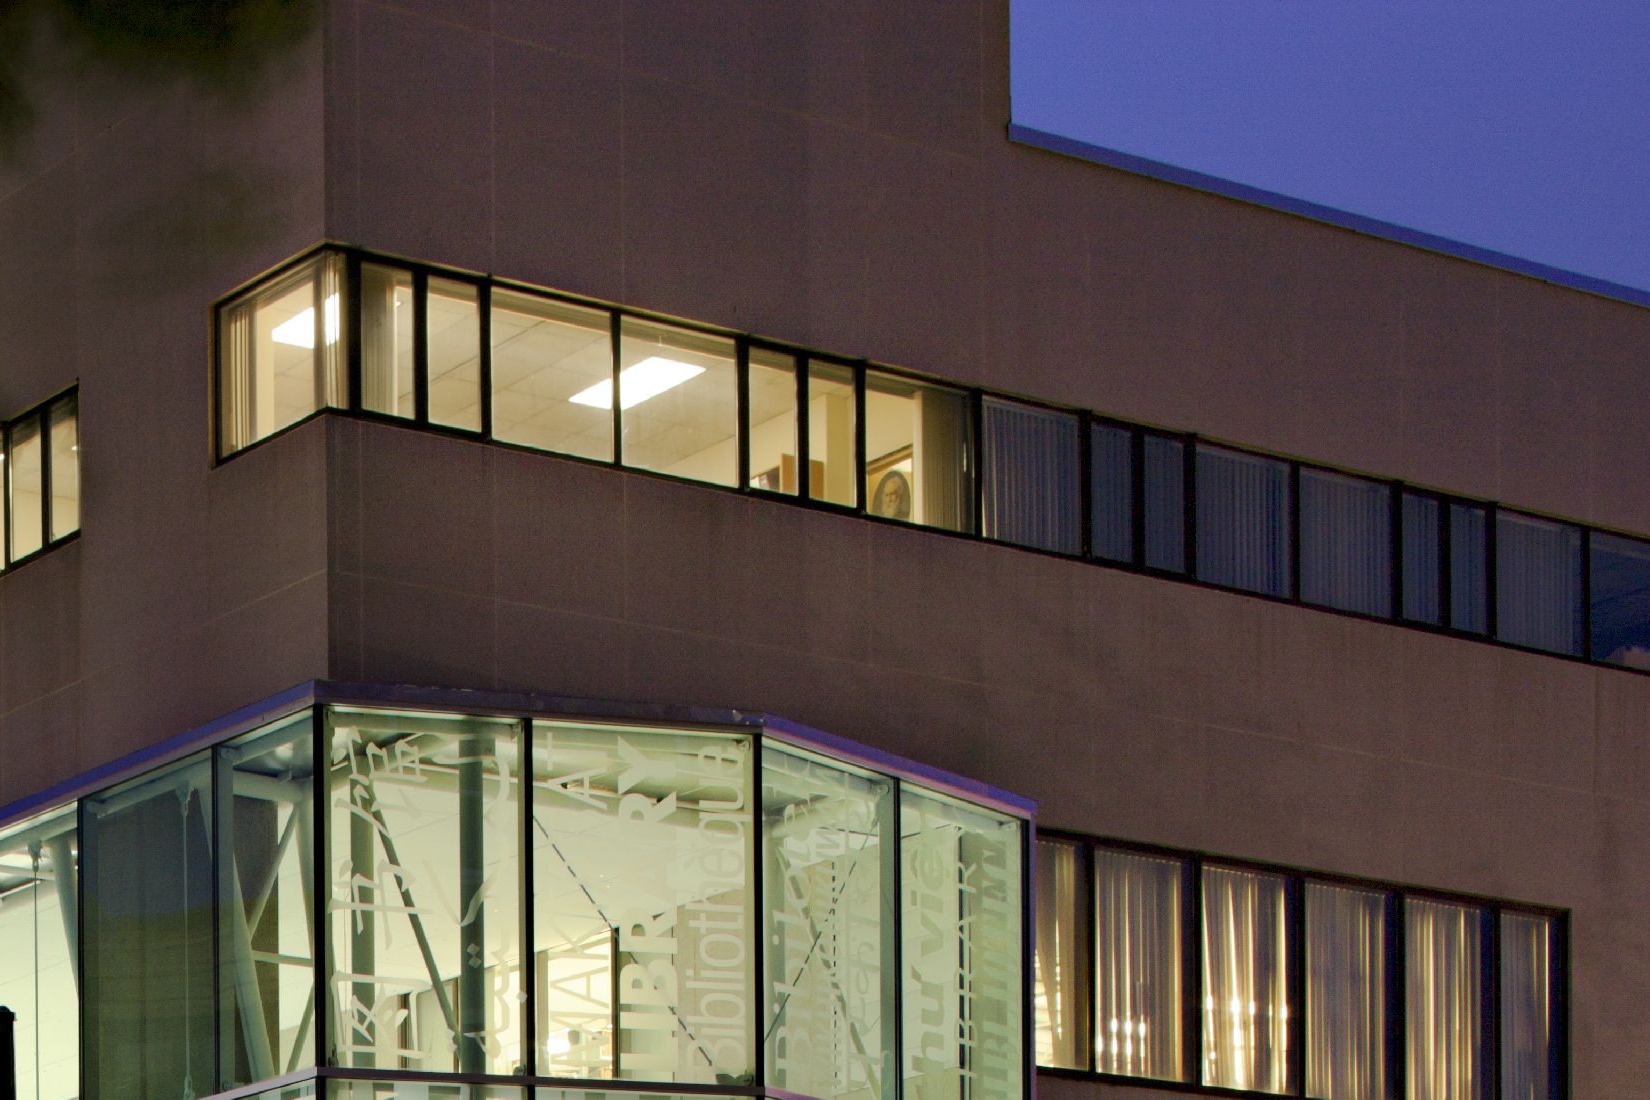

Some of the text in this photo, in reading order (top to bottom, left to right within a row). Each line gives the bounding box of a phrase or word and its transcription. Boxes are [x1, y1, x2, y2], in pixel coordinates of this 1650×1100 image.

[327, 724, 433, 1063] 图书馆
[617, 735, 679, 1072] LIBRARY
[686, 740, 752, 1076] Bibliothèque
